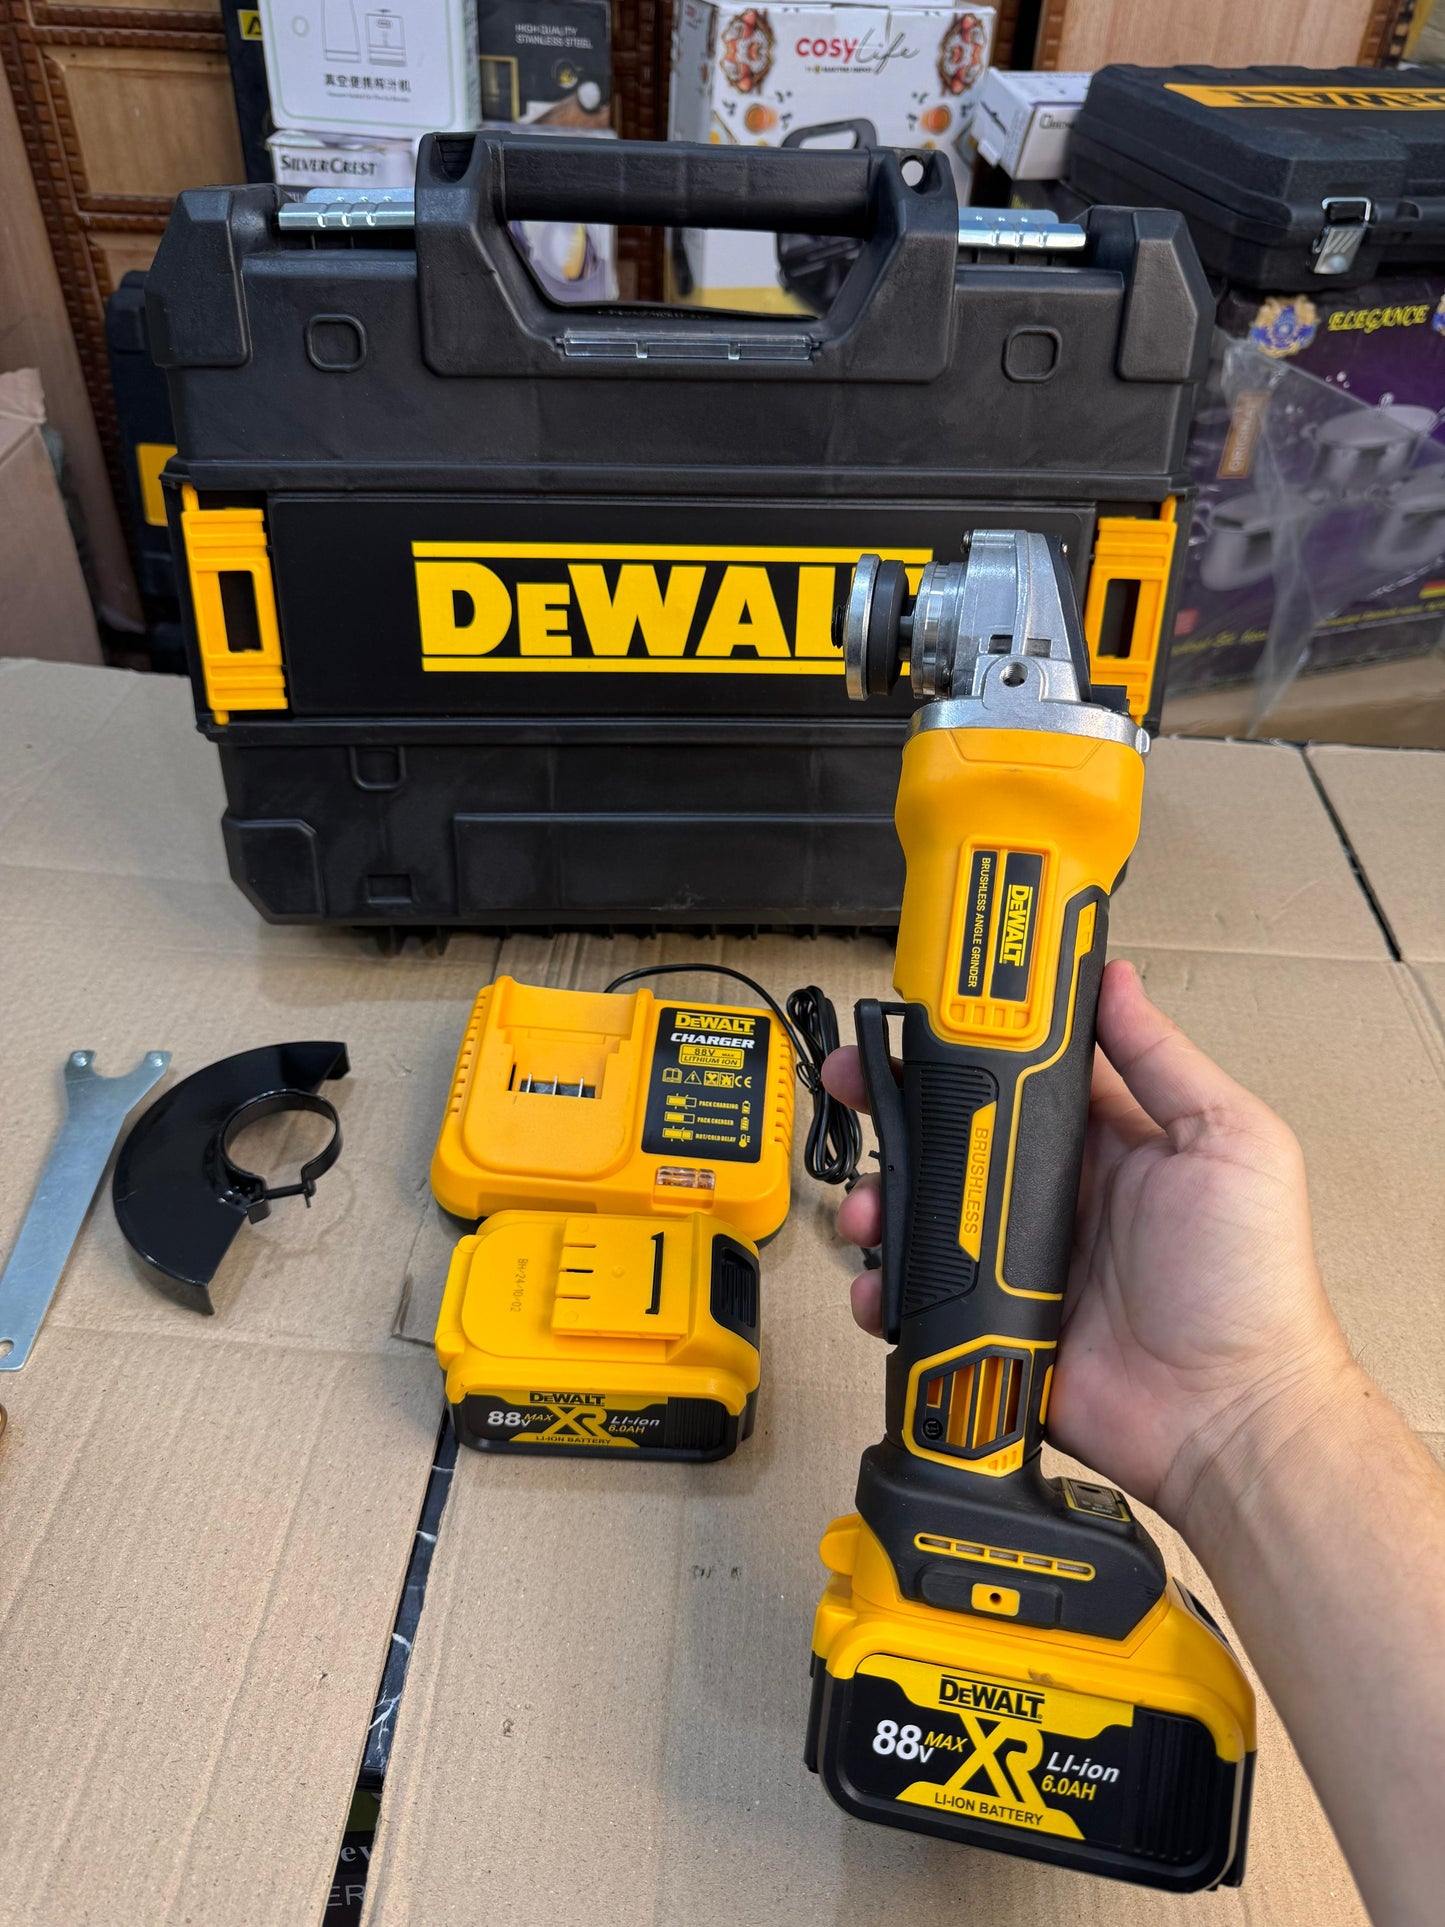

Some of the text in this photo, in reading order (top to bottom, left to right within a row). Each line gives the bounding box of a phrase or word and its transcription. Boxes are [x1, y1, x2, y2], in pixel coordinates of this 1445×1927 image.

[514, 24, 540, 34] HIGH
[1327, 304, 1430, 334] ELEGANCE
[967, 857, 992, 988] BRUSHLESS ANGLE GRINDER
[1001, 884, 1032, 966] DEWALT
[674, 1013, 756, 1034] DEWALT
[670, 1032, 756, 1049] CHARGER
[683, 1055, 719, 1064] LITHIUM
[694, 1048, 716, 1057] 88V
[697, 1116, 711, 1124] PACK
[964, 1127, 989, 1234] BRUSHLESS
[529, 1392, 606, 1406] DEWALT
[524, 1413, 554, 1422] MAX
[535, 1435, 612, 1445] LI-ION BATTERY
[608, 1425, 646, 1435] 6.0AH
[938, 1675, 1045, 1722] DEWALT
[923, 1730, 968, 1753] MAX
[944, 1713, 1048, 1808] XR
[1041, 1773, 1098, 1801] 6.0AH
[934, 1792, 1044, 1827] LI-ION BATTERY
